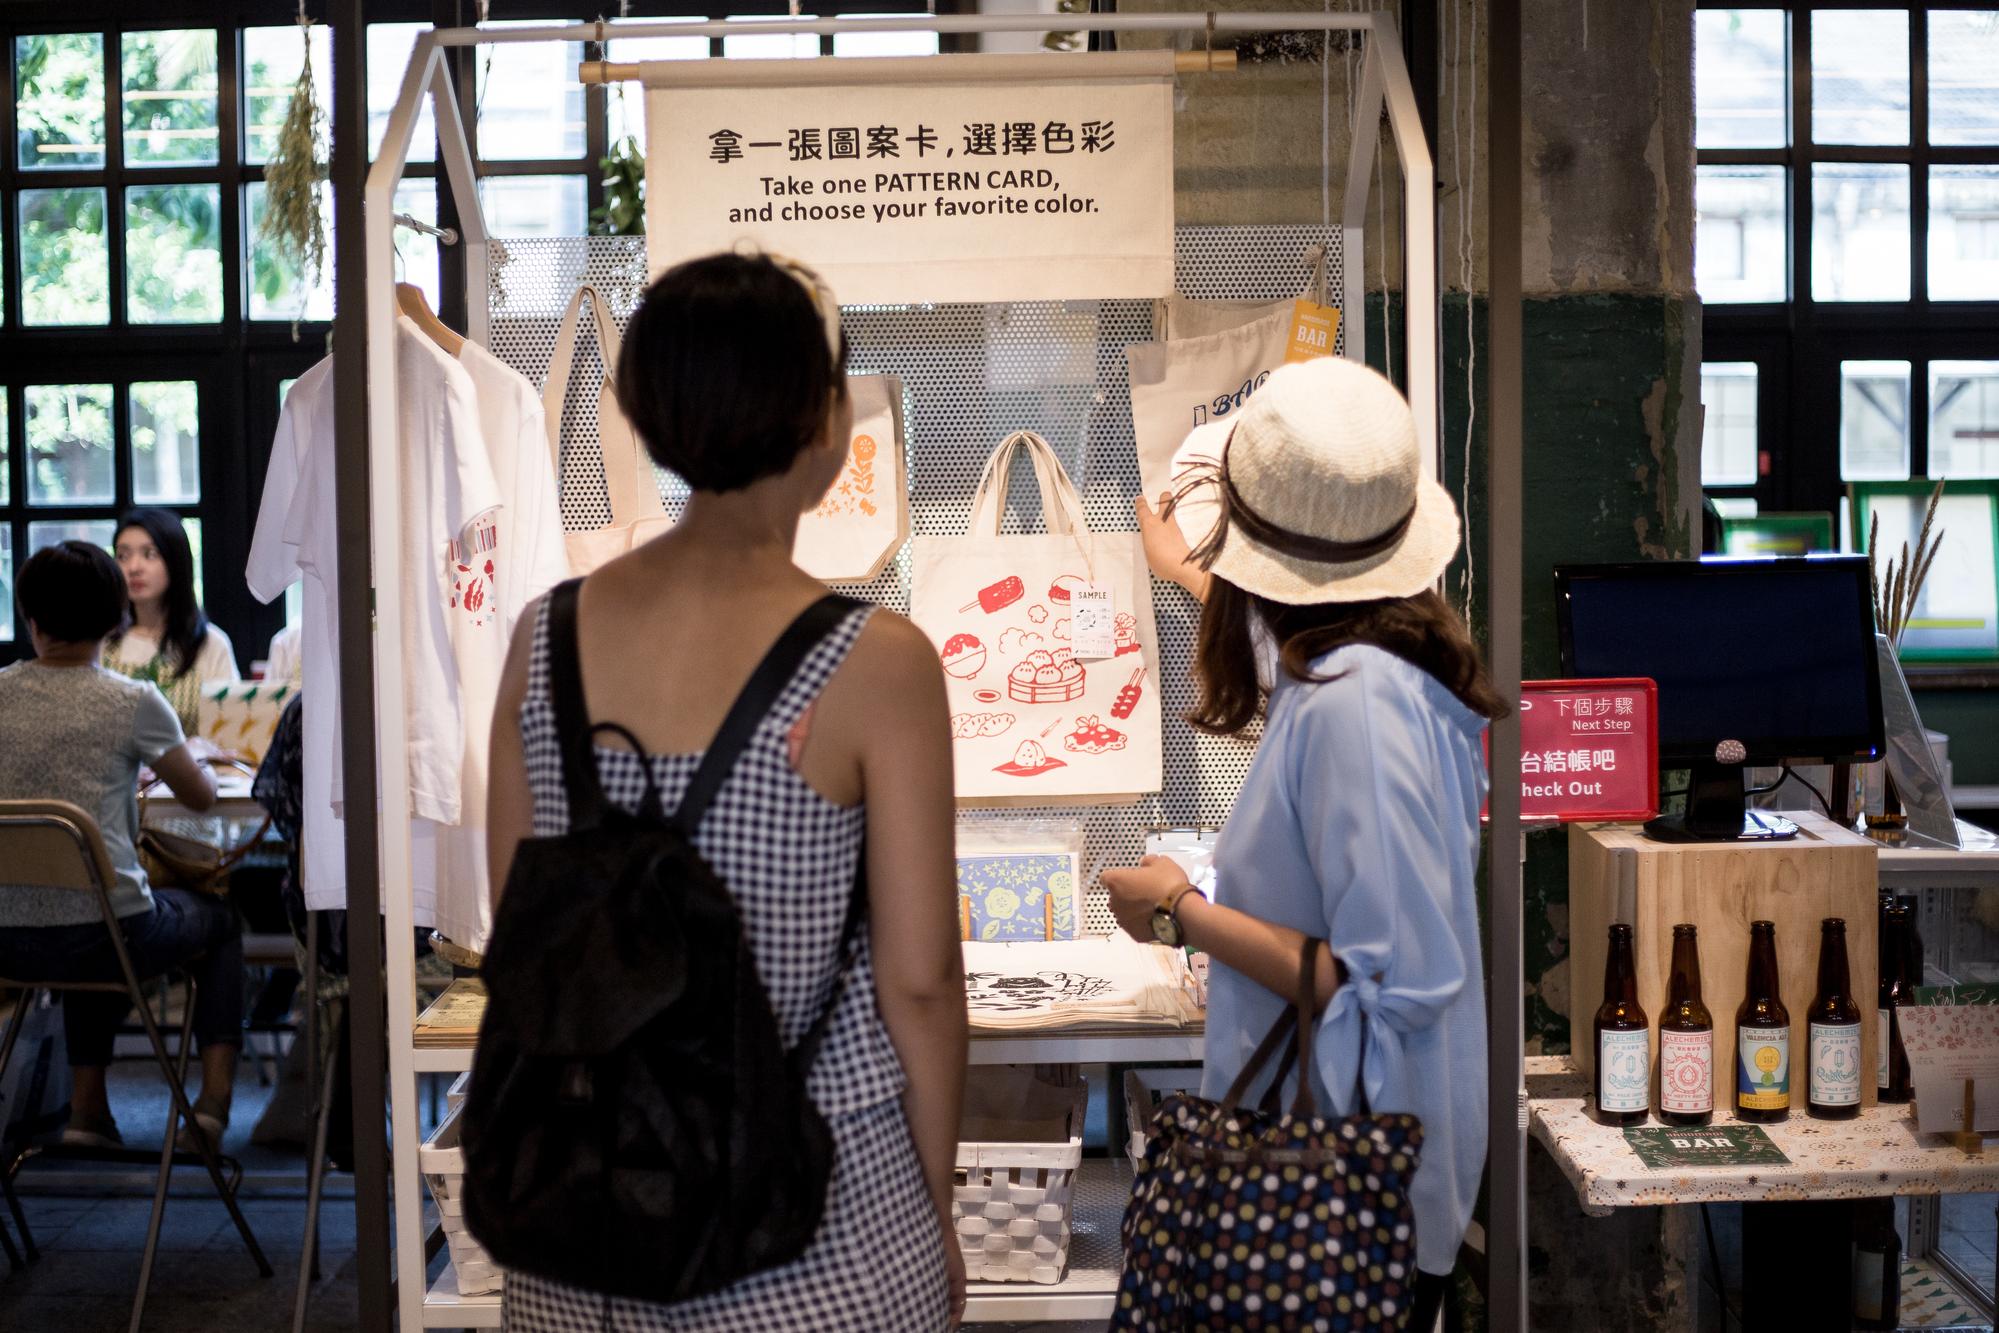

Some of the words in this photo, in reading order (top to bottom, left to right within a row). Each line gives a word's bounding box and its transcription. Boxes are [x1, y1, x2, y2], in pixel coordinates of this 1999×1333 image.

[760, 175, 814, 196] Take
[822, 178, 867, 194] one
[875, 171, 980, 193] PATTERN
[987, 169, 1060, 191] CARD,
[729, 202, 773, 223] and
[781, 200, 865, 221] choose
[872, 200, 927, 223] your
[935, 195, 1028, 217] favorite
[1034, 193, 1099, 213] color.
[1296, 325, 1328, 348] BAR
[1078, 591, 1107, 600] SAMPLE
[1553, 697, 1633, 717] 下個步驟
[1572, 720, 1601, 730] Next
[1604, 719, 1631, 731] Step
[1520, 749, 1616, 774] 台結帳吧
[1521, 781, 1564, 797] heck
[1569, 781, 1602, 796] Out
[1670, 1138, 1734, 1148] BAR
